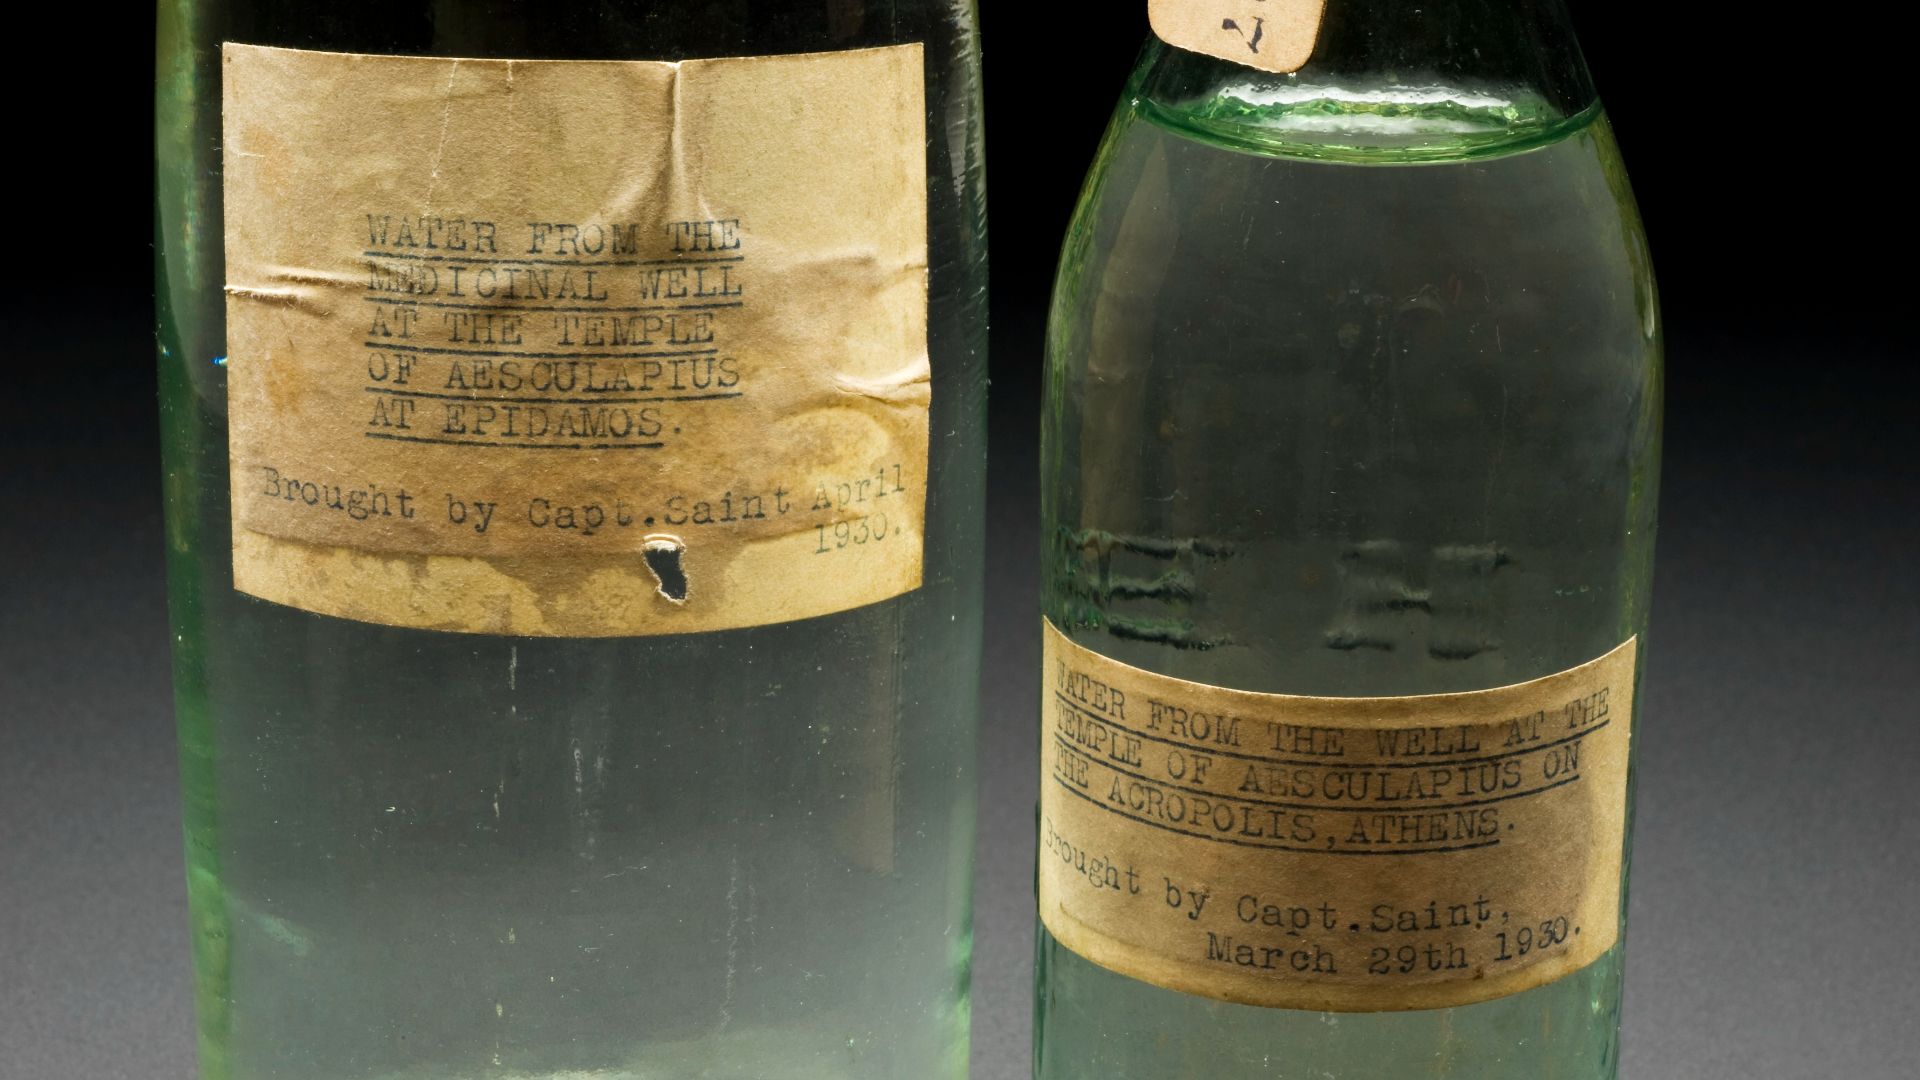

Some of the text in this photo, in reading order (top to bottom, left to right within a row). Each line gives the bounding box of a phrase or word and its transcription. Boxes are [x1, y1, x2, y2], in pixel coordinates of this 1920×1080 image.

[367, 213, 742, 256] WATER FROM THE
[367, 260, 743, 302] MEDICINAL WELL
[368, 306, 714, 346] AT THE TEMPLE
[367, 352, 741, 393] OF AESCULAPIUS
[369, 398, 682, 439] AT EPIDAMOS.
[261, 467, 415, 521] Brought
[449, 493, 498, 532] by
[811, 463, 905, 513] April
[815, 512, 900, 554] 1930.
[1056, 657, 1609, 757] WATER FROM THE WELL AT THE
[1054, 740, 1089, 789] THE
[1055, 700, 1582, 800] TEMPLE OF AESCULAPIUS ON
[1046, 817, 1140, 895] Brought
[1163, 876, 1210, 921] by
[1206, 914, 1582, 976] March 29th 1930.
